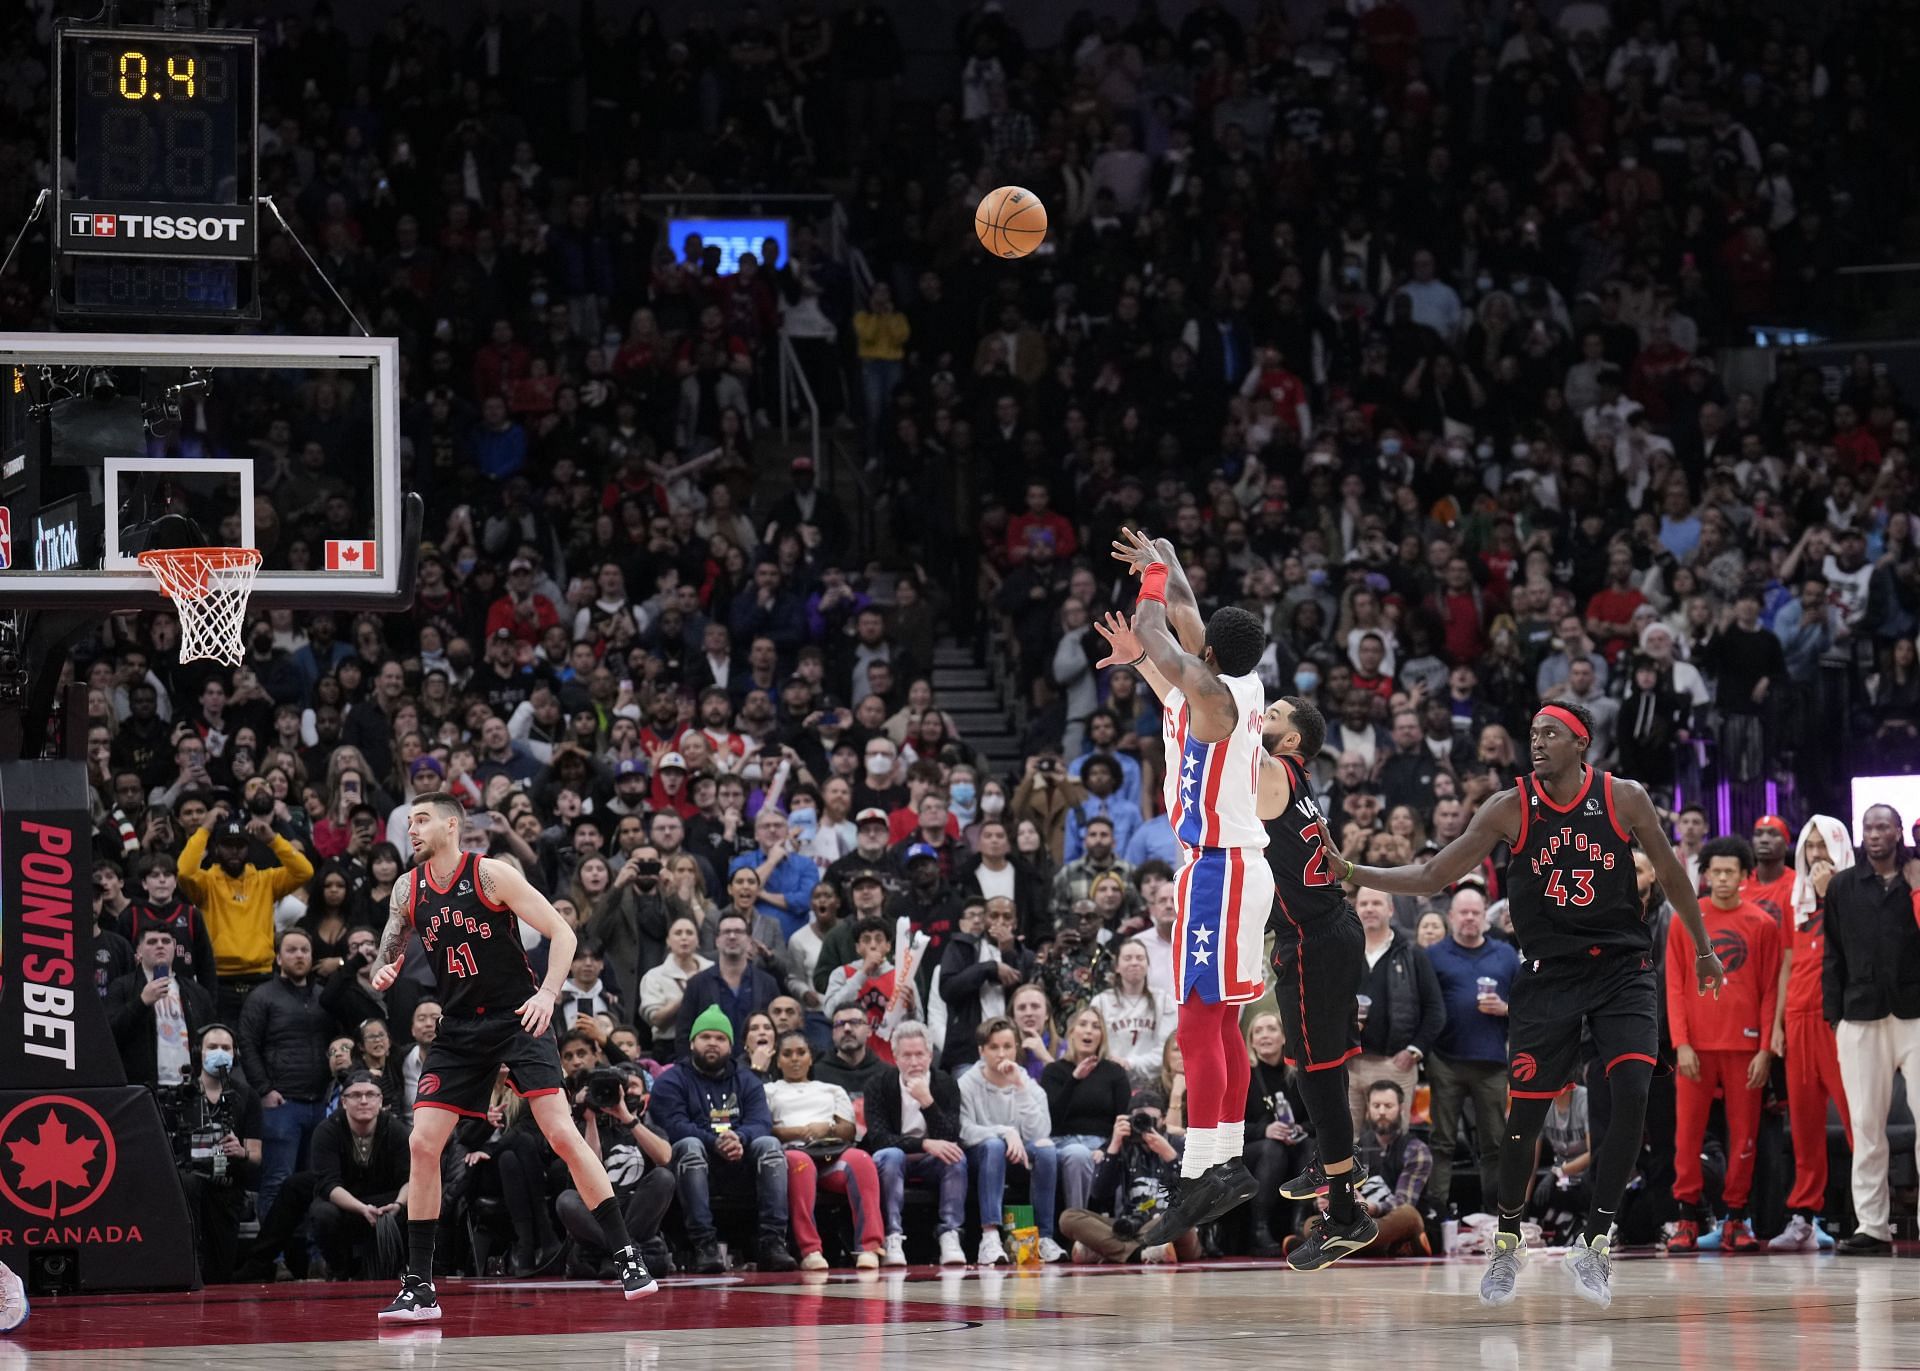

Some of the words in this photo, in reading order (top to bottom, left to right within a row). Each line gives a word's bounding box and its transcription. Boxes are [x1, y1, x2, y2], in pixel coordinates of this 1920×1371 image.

[119, 52, 195, 100] 0.4
[119, 214, 245, 241] TISSOT
[45, 520, 79, 571] TikTok
[1531, 827, 1615, 876] RAPTORS
[1544, 869, 1595, 907] 43
[20, 820, 76, 1071] POINTSBET
[422, 906, 492, 952] RAPTORS
[446, 942, 479, 978] 41
[1130, 1030, 1138, 1046] 7
[23, 1225, 144, 1246] CANADA
